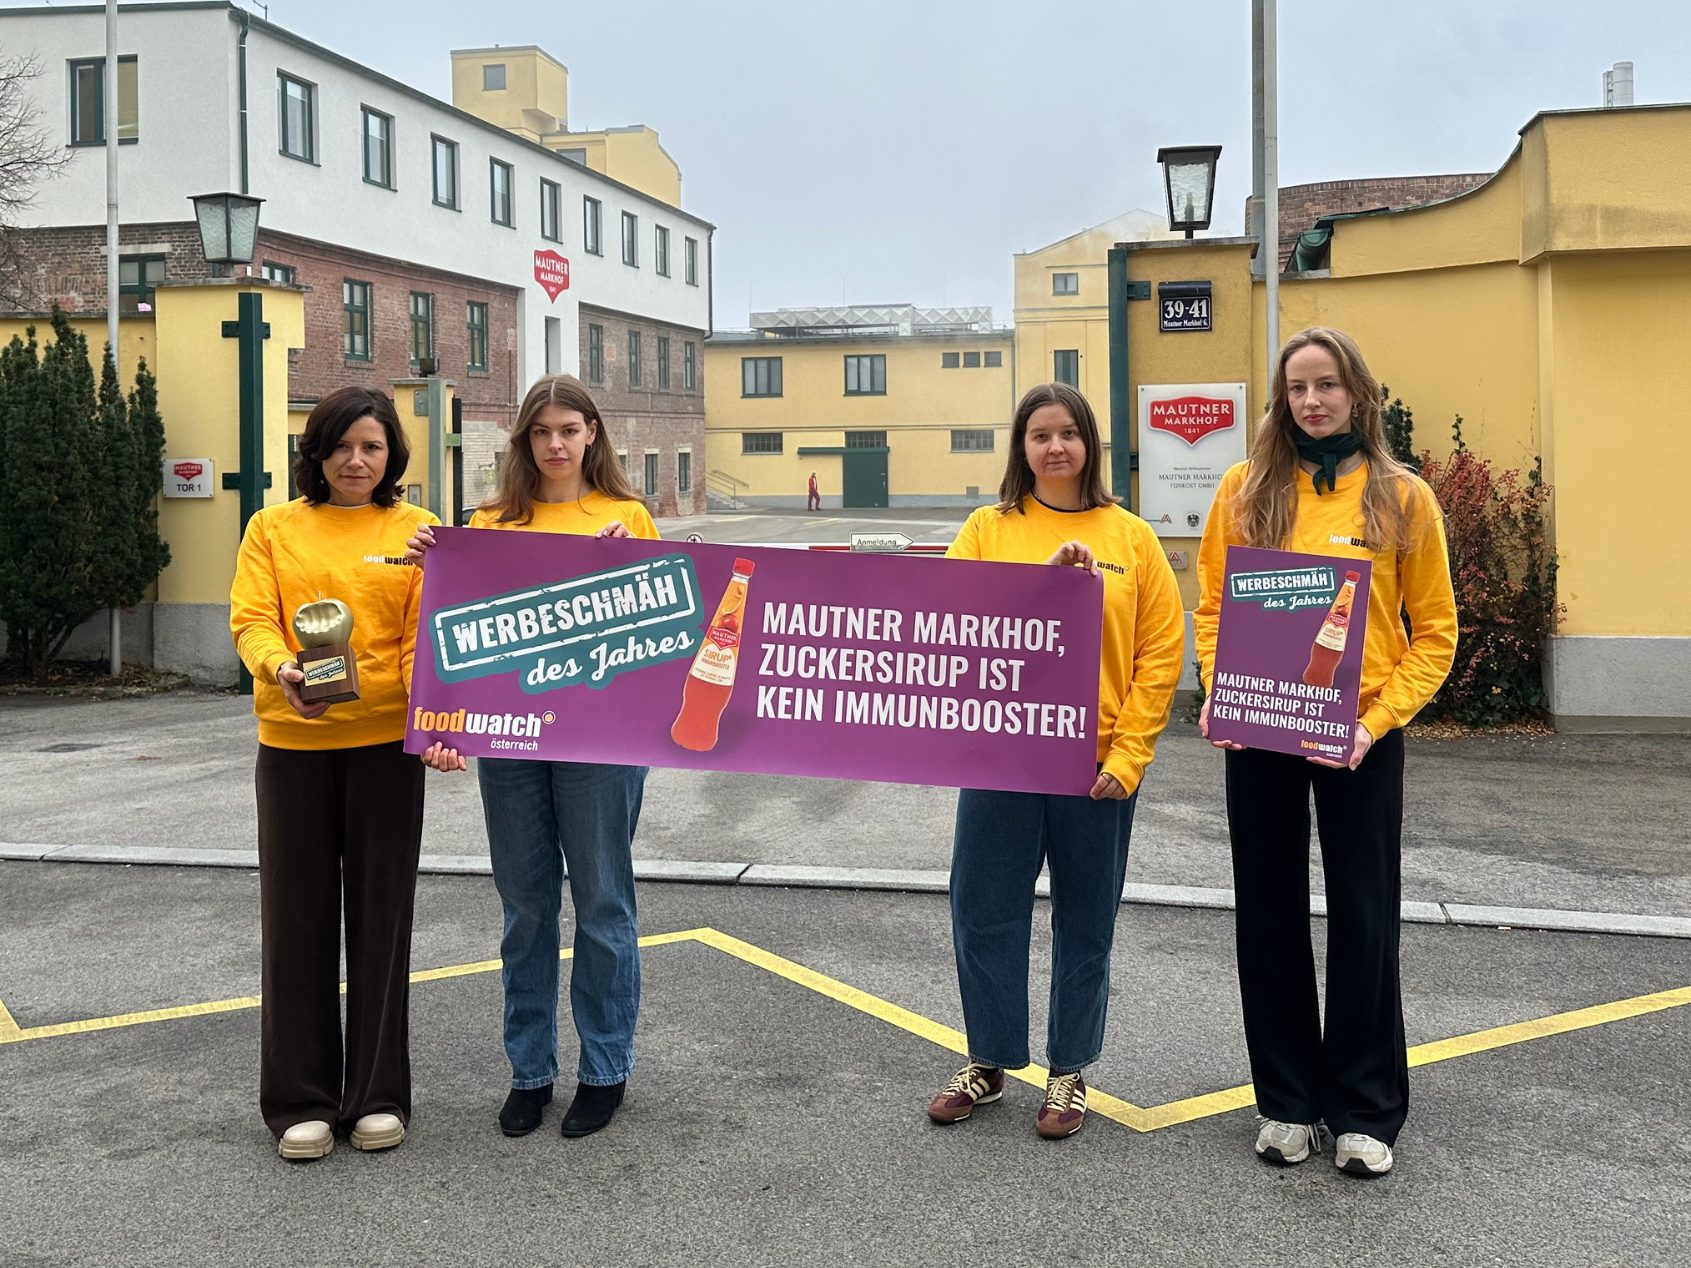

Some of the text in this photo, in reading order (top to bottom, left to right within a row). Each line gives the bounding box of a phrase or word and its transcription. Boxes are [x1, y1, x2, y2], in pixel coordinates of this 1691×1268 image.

[535, 255, 568, 275] MAUTNER
[540, 271, 564, 285] MARKHOF
[1164, 299, 1208, 318] 39-41
[1153, 404, 1230, 415] MAUTNER
[1164, 416, 1219, 425] MARKHOF
[176, 484, 201, 492] TOR 1
[1329, 534, 1369, 549] foodwa
[1237, 570, 1328, 592] WERBESCHMÄH
[1263, 595, 1333, 610] des Jahres
[452, 573, 678, 654] WERBESCHMÄH
[762, 602, 1065, 657] MAUTNER MARKHOF,
[526, 631, 695, 686] des Jahres
[758, 643, 1025, 692] ZUCKERSIRUP IST
[1216, 671, 1342, 705] MAUTNER MARKHOF,
[756, 685, 1087, 739] KEIN IMMUNBOOSTER!
[1214, 687, 1325, 717] ZUCKERSIRUP IST
[413, 706, 542, 737] foodwatch
[1213, 704, 1350, 739] KEIN IMMUNBOOSTER!
[490, 737, 538, 751] österreich
[1300, 740, 1343, 754] foodwatch
